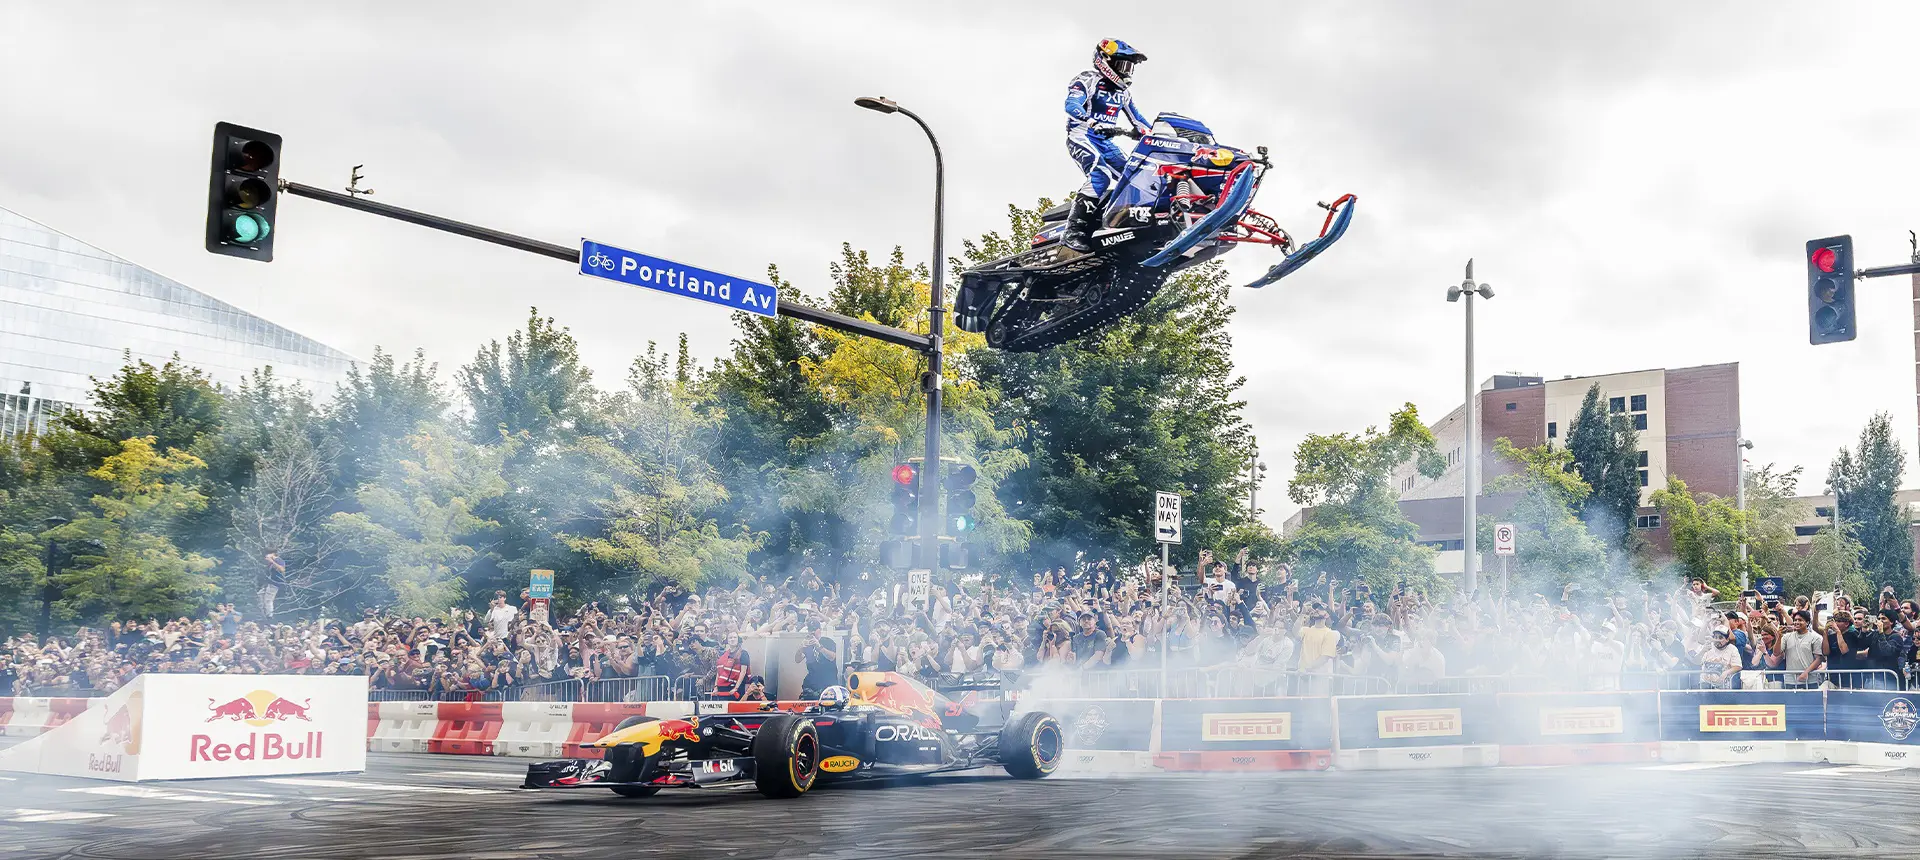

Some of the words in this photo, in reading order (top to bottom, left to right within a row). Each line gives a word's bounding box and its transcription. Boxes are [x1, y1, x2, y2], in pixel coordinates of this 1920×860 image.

[1128, 206, 1152, 223] FOX
[620, 256, 731, 300] Portland
[742, 287, 772, 309] Av
[1159, 496, 1177, 509] ONE
[1158, 510, 1177, 523] WAY
[911, 573, 927, 583] ONE
[911, 585, 927, 595] WAY
[1385, 714, 1455, 733] PIRELLI
[1707, 709, 1778, 726] PIRELLI
[1210, 718, 1283, 735] PIRELLI
[190, 733, 256, 762] Red
[263, 731, 323, 760] Bull
[89, 753, 105, 772] Red
[105, 755, 122, 774] Bull
[702, 759, 735, 774] Mobil
[829, 760, 855, 768] RAUCH
